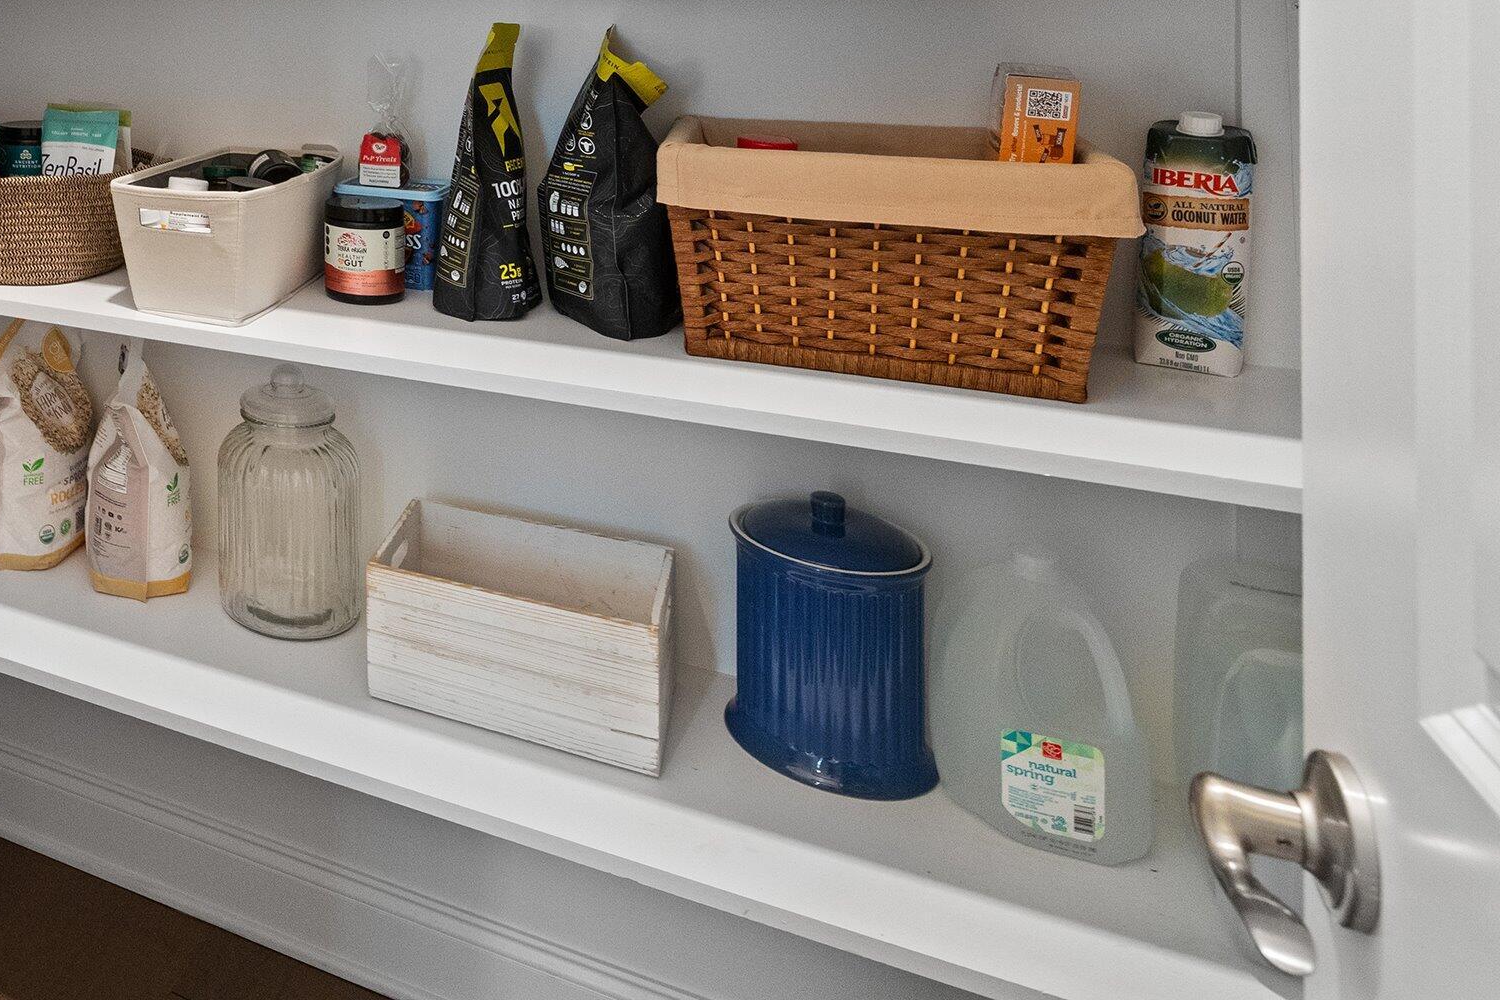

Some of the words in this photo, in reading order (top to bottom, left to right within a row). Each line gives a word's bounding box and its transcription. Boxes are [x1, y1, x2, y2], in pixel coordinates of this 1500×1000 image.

[42, 153, 102, 177] ZenBasil
[376, 155, 397, 163] Treats
[1152, 168, 1239, 196] IBERIA
[1173, 201, 1195, 209] ALL
[1200, 202, 1245, 211] NATURAL
[169, 211, 200, 219] Supplement
[1171, 209, 1217, 225] COCONUT
[1220, 212, 1247, 226] WATER
[344, 259, 364, 267] GUT
[1164, 336, 1208, 350] HYDRATION
[1168, 331, 1204, 343] ORGANIC
[23, 476, 45, 486] FREE
[1006, 763, 1055, 786] spring
[1028, 760, 1077, 779] natural
